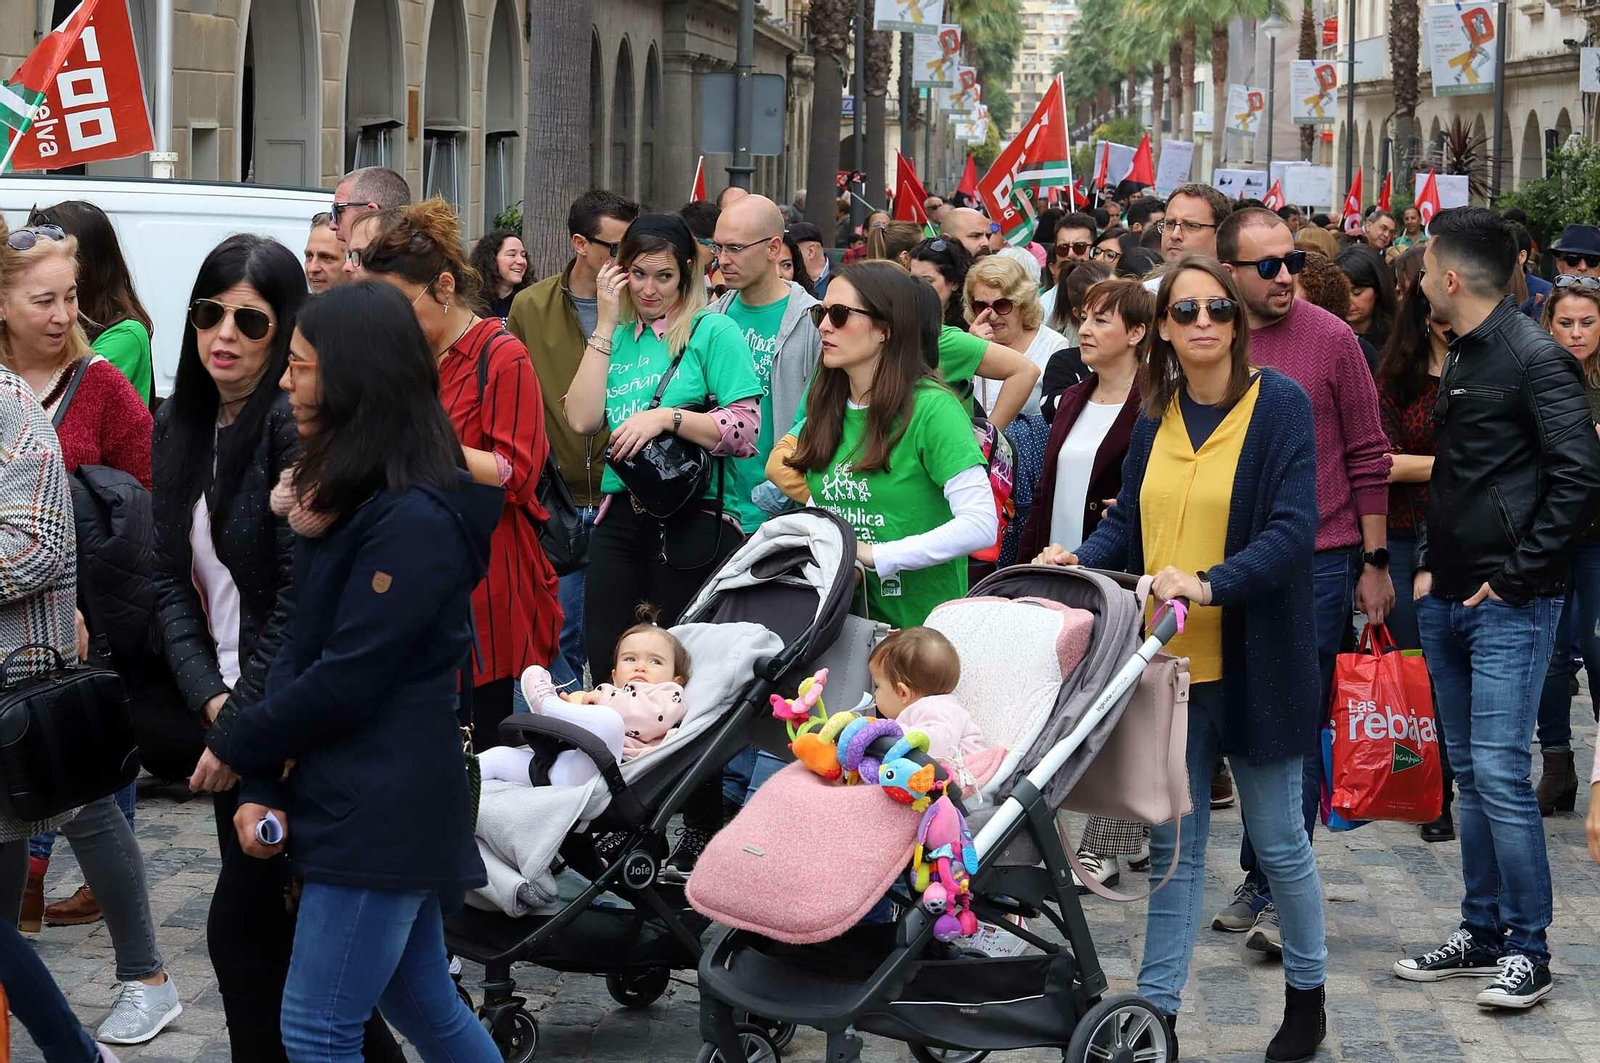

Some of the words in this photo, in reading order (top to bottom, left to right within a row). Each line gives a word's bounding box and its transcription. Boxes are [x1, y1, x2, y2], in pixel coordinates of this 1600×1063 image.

[608, 363, 633, 374] Por
[637, 355, 650, 369] la
[606, 368, 680, 399] señana
[1347, 697, 1376, 713] Las
[630, 863, 651, 875] Joie
